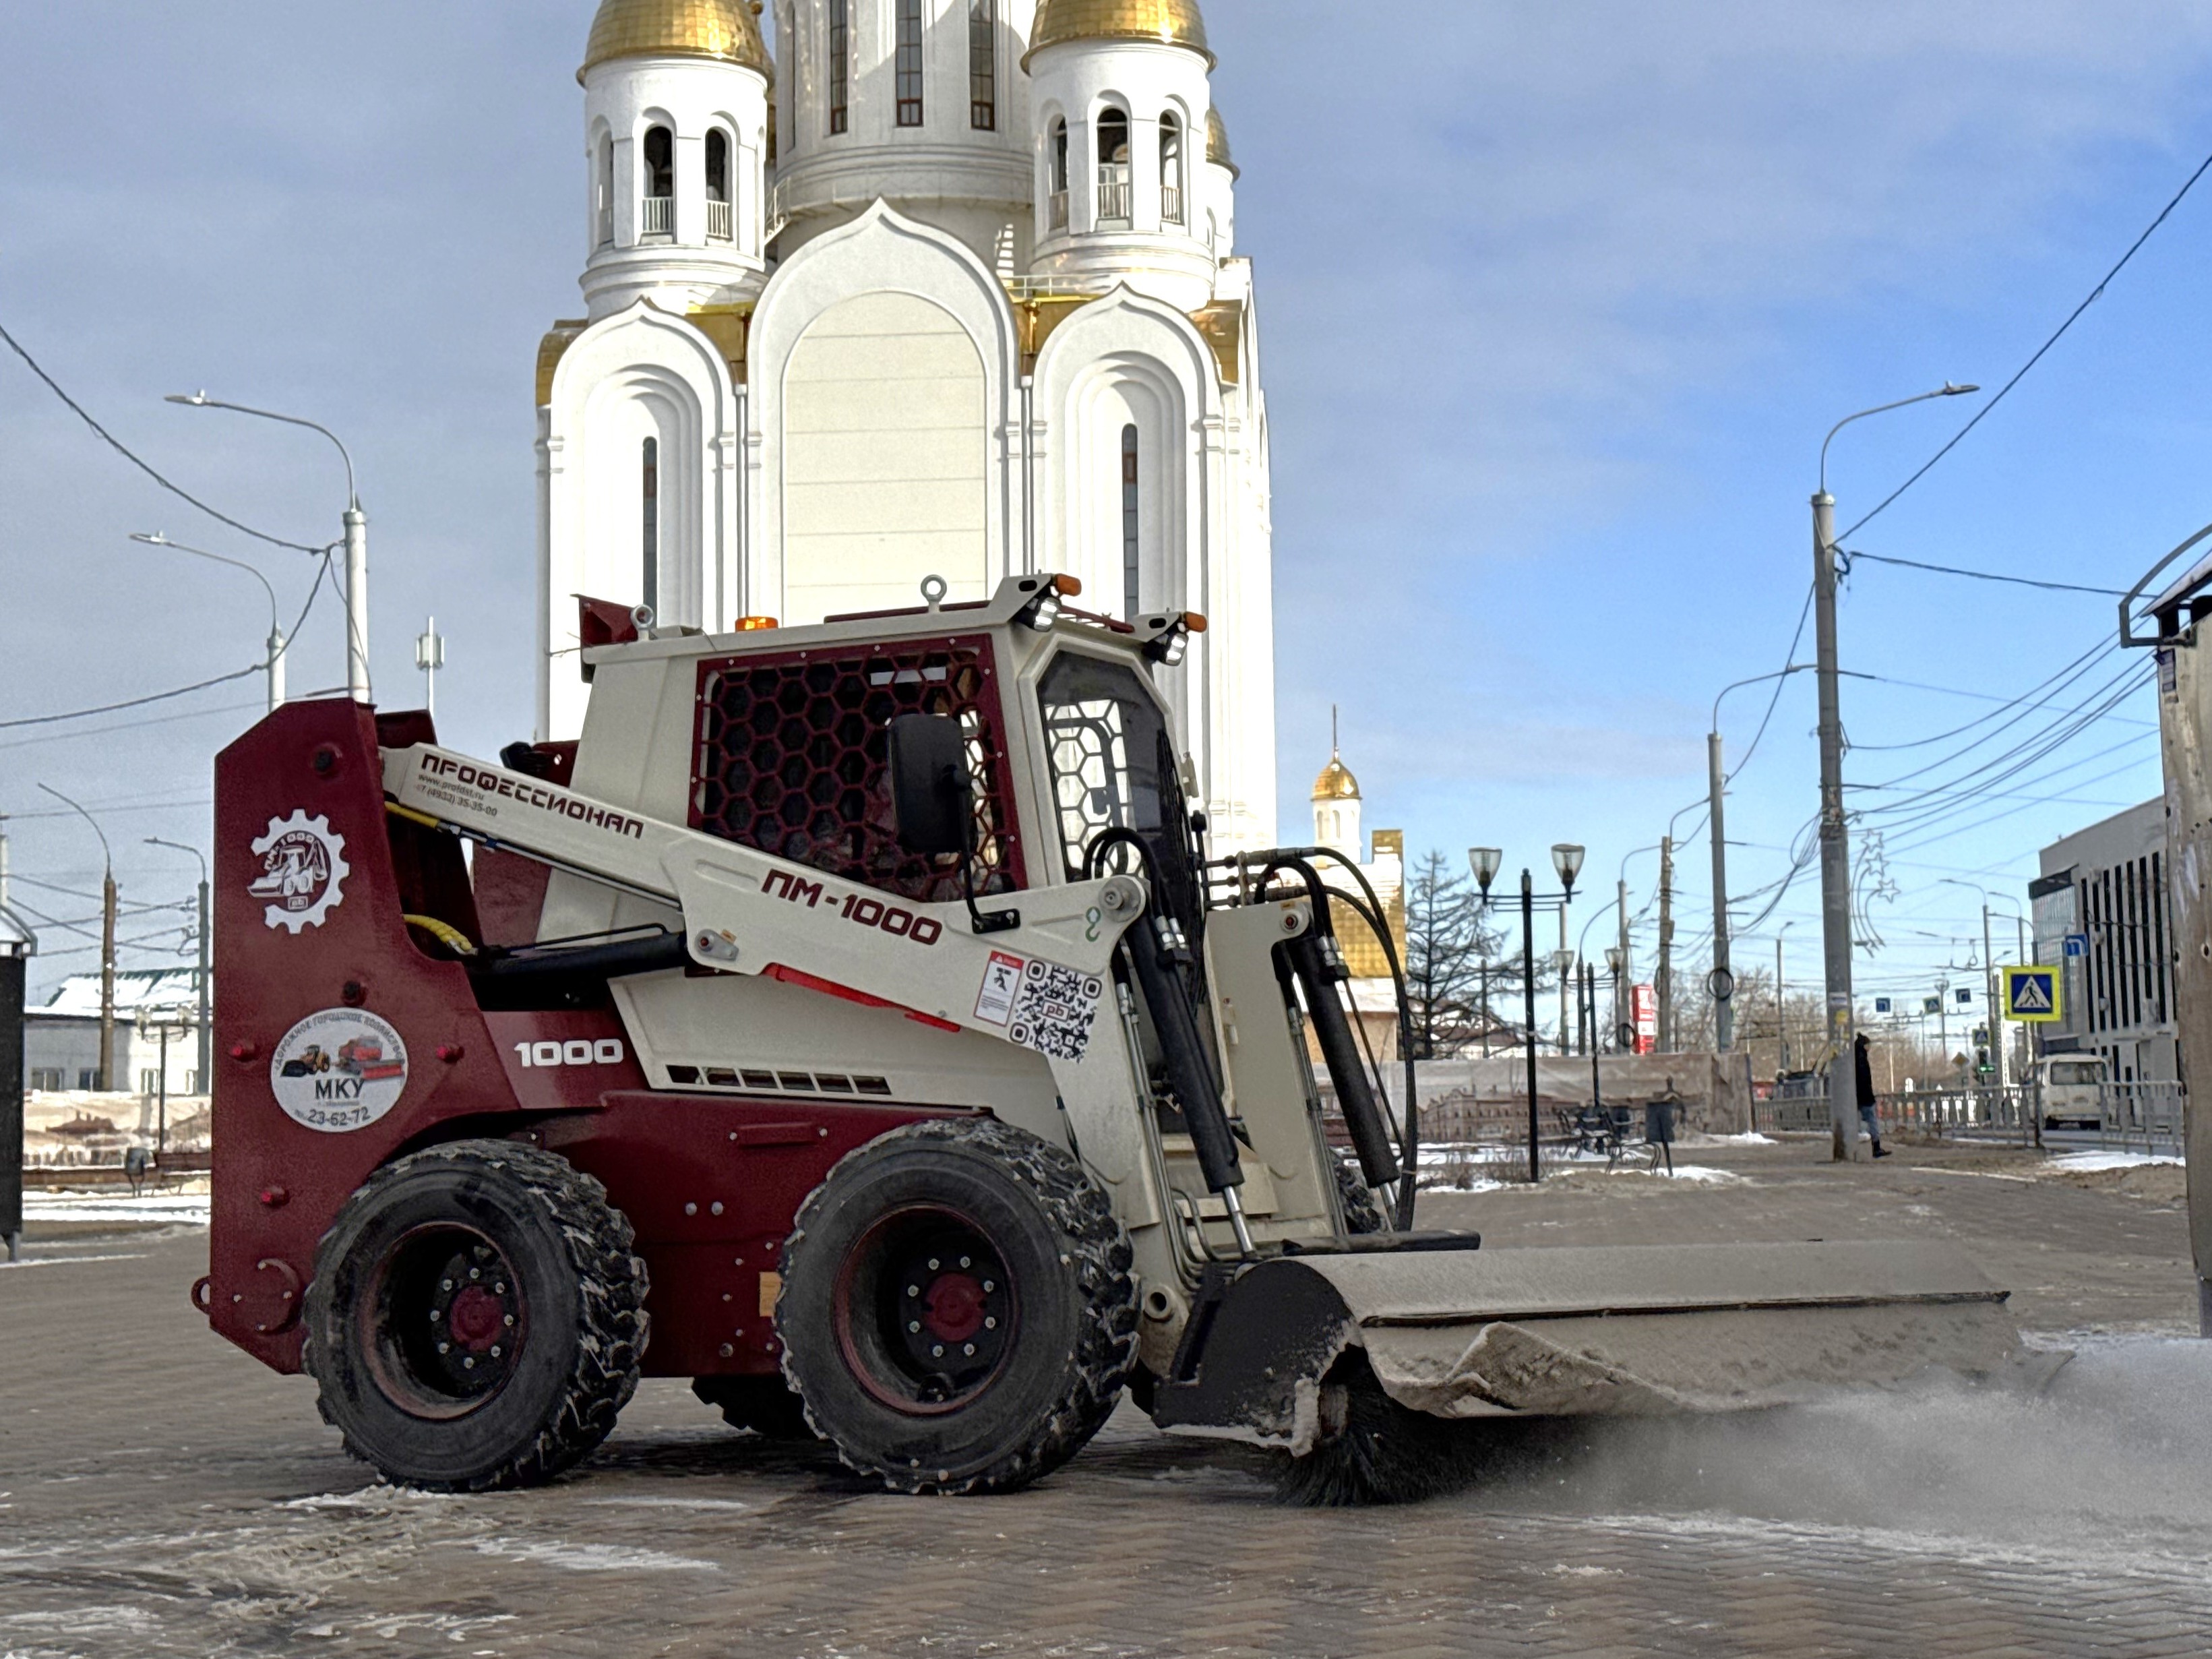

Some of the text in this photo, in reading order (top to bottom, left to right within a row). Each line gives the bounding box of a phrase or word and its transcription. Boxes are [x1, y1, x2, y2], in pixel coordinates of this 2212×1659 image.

[514, 1038, 624, 1067] 1000
[315, 1078, 365, 1099] МКУ
[307, 1106, 371, 1126] 23-62-72
